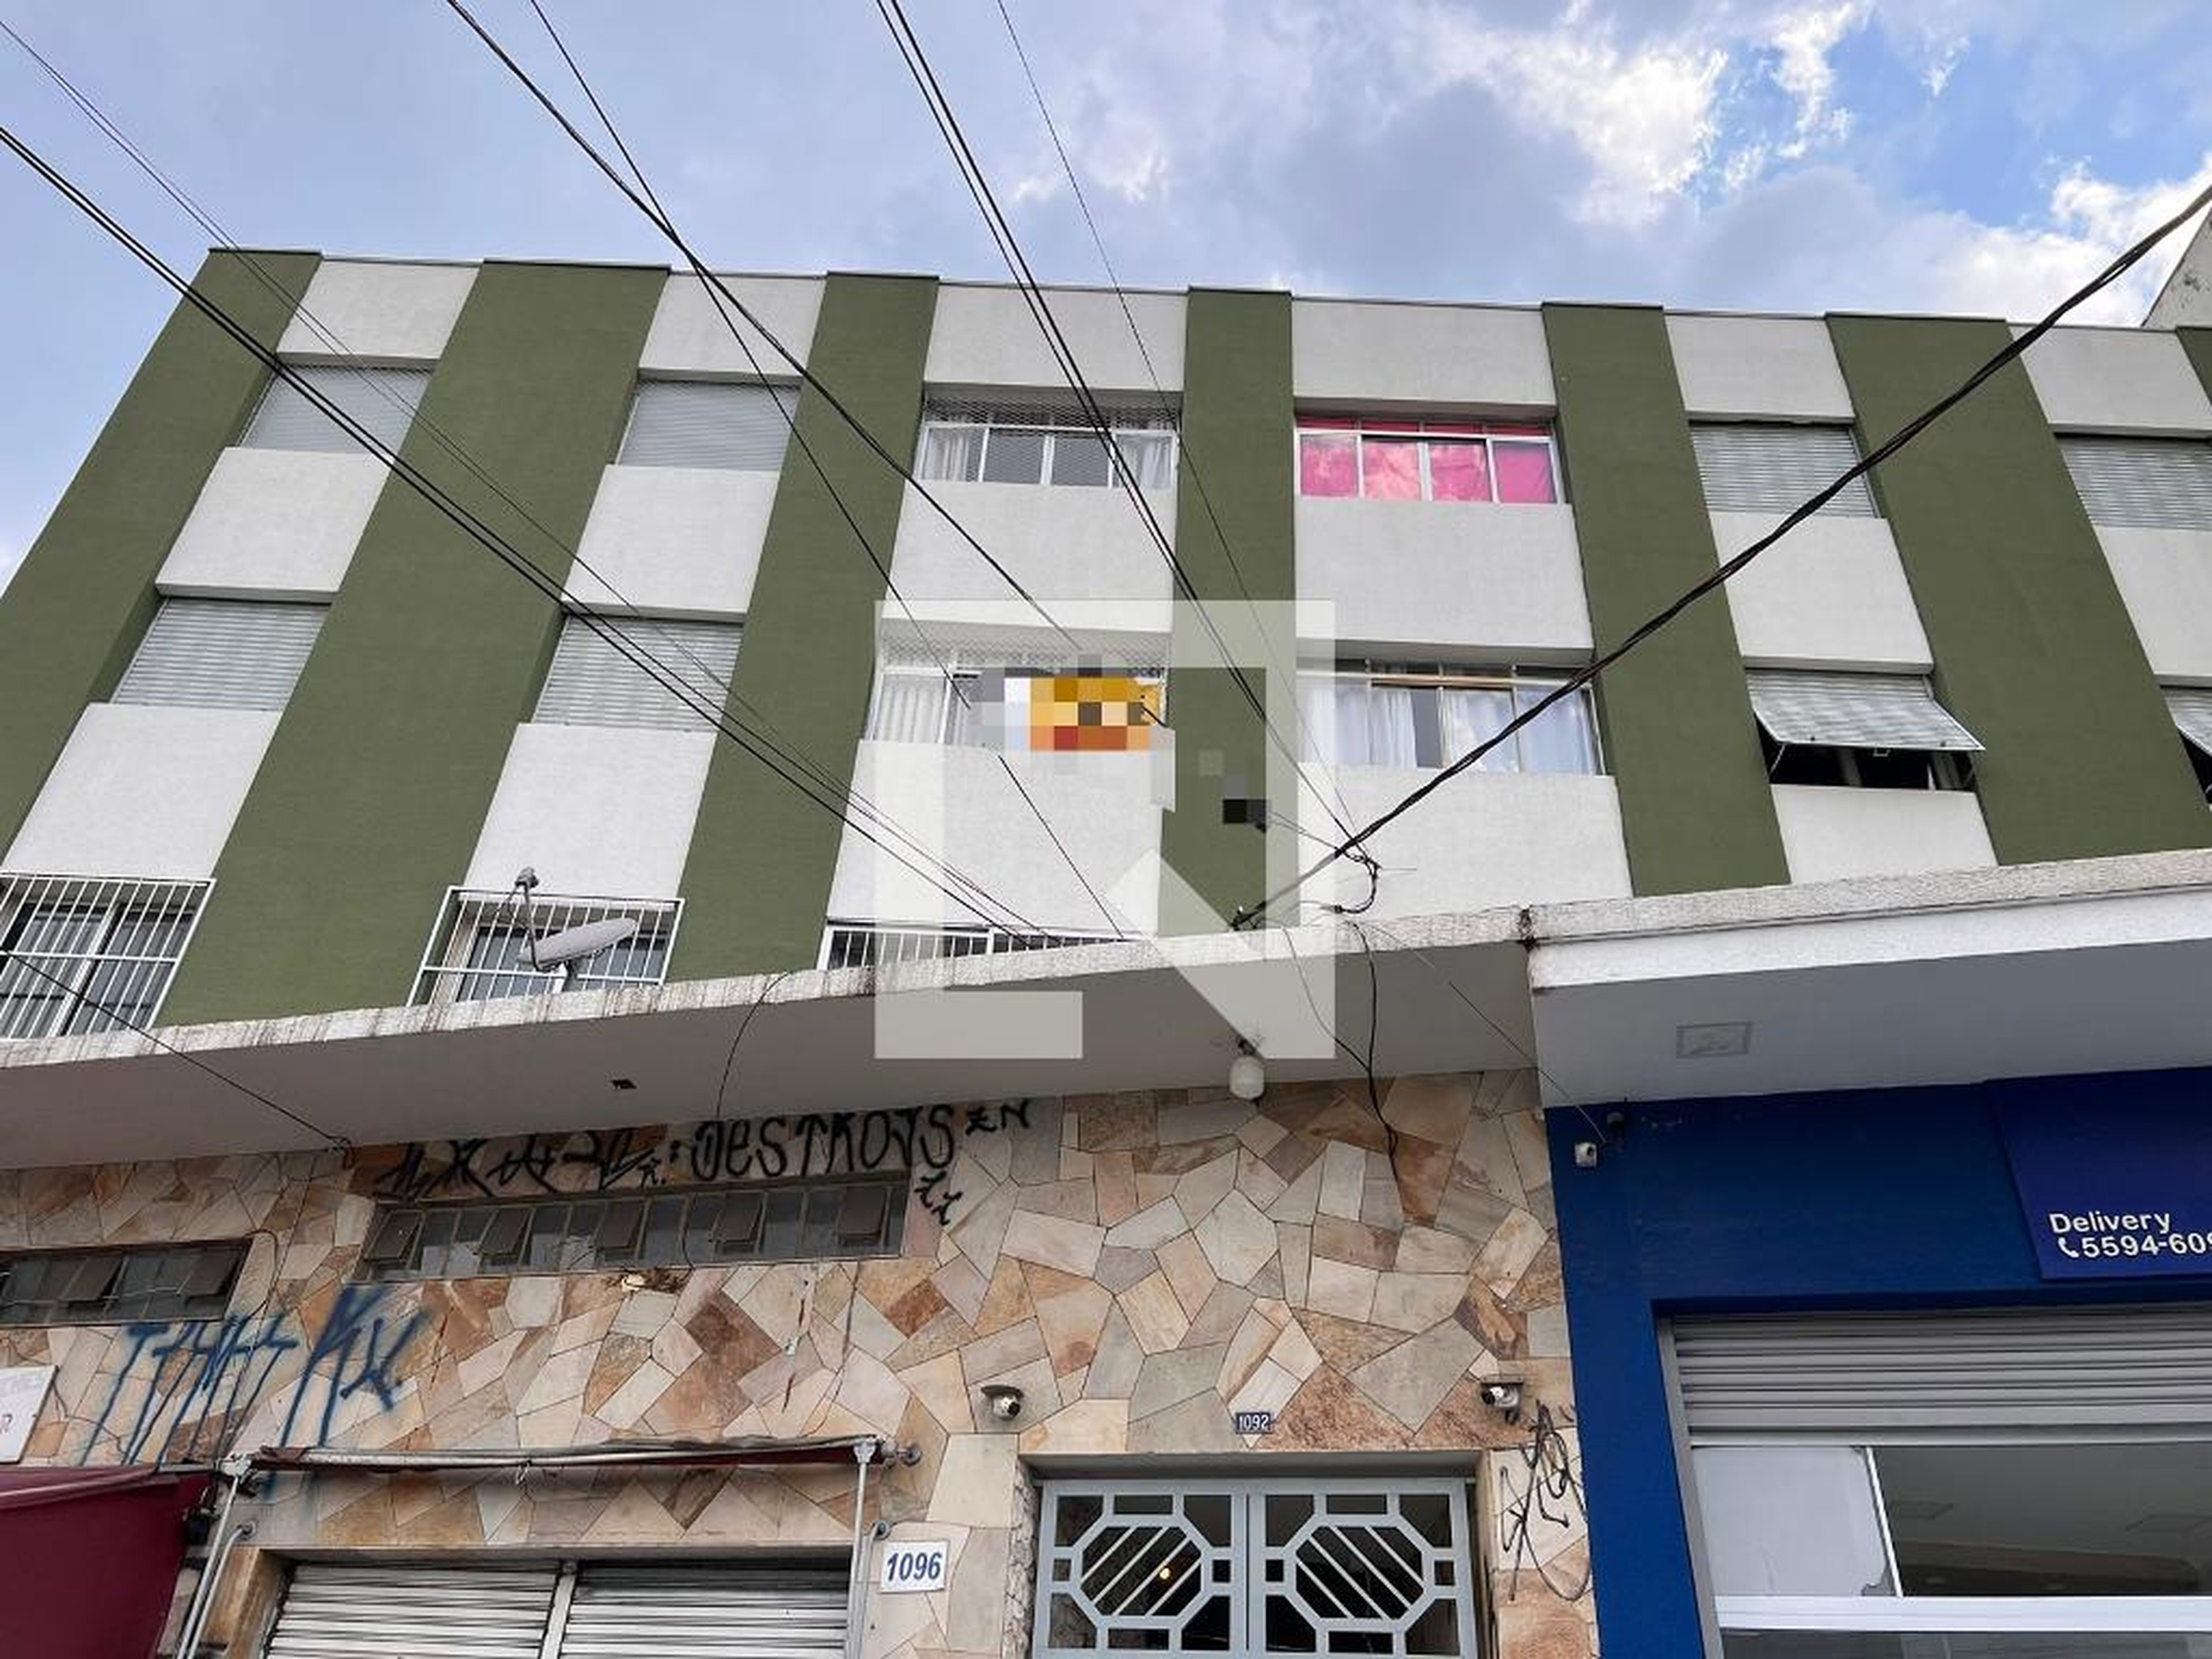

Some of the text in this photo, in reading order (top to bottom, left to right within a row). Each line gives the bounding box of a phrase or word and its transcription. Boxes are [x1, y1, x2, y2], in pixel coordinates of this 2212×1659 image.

[2048, 1211, 2170, 1234] Delivery
[1239, 1414, 1269, 1430] 1092
[887, 1552, 942, 1581] 1096
